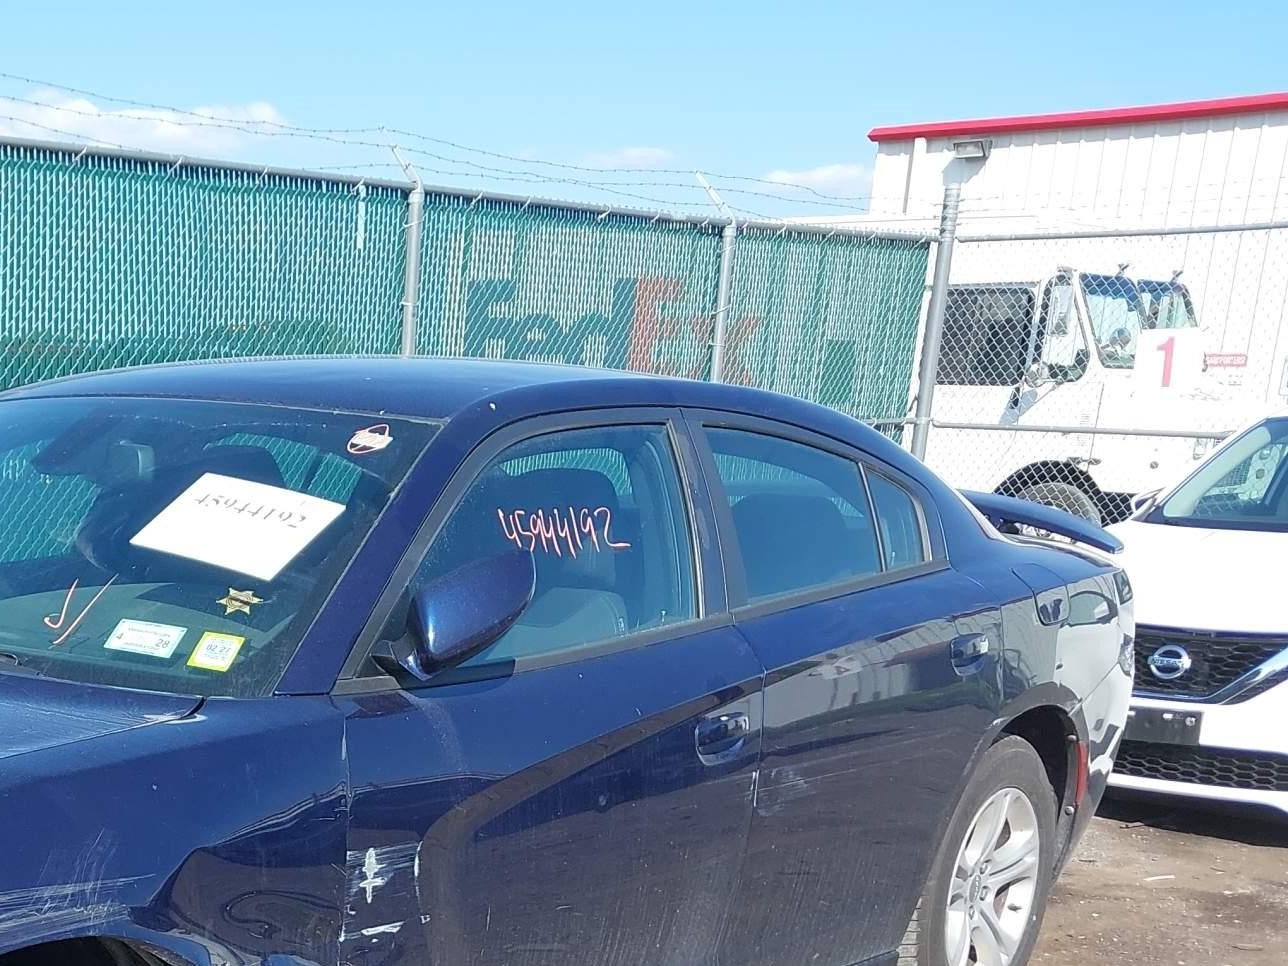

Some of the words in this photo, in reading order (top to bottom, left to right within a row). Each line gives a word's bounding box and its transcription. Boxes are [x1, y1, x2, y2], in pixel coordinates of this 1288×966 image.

[463, 276, 762, 386] FedEx
[1156, 336, 1175, 387] 1
[497, 506, 632, 559] 45944192
